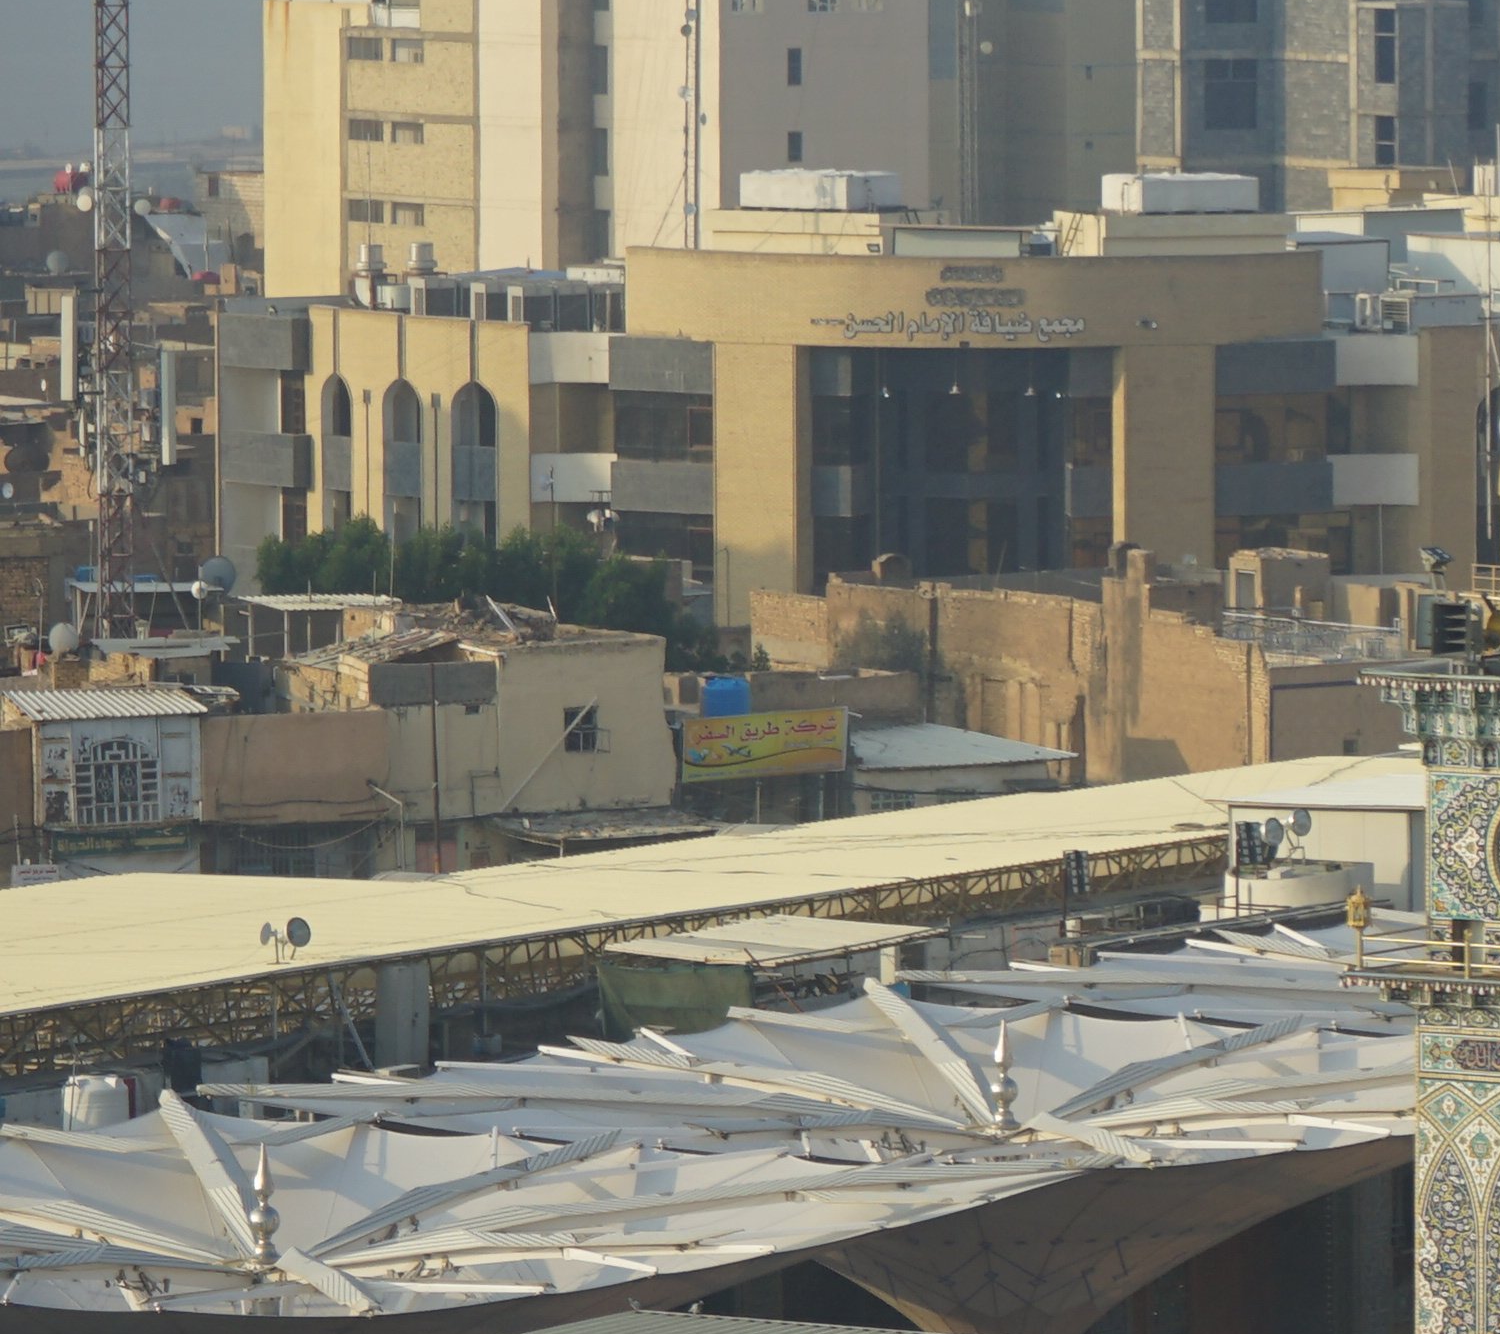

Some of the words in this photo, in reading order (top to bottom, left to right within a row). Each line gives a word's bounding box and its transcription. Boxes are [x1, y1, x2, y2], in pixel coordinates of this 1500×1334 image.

[843, 310, 904, 338] الحسن
[969, 310, 1033, 340] ضيافة
[1037, 316, 1086, 342] مجمع
[695, 724, 735, 745] السفر
[740, 721, 780, 742] طريق
[784, 715, 837, 736] شركة
